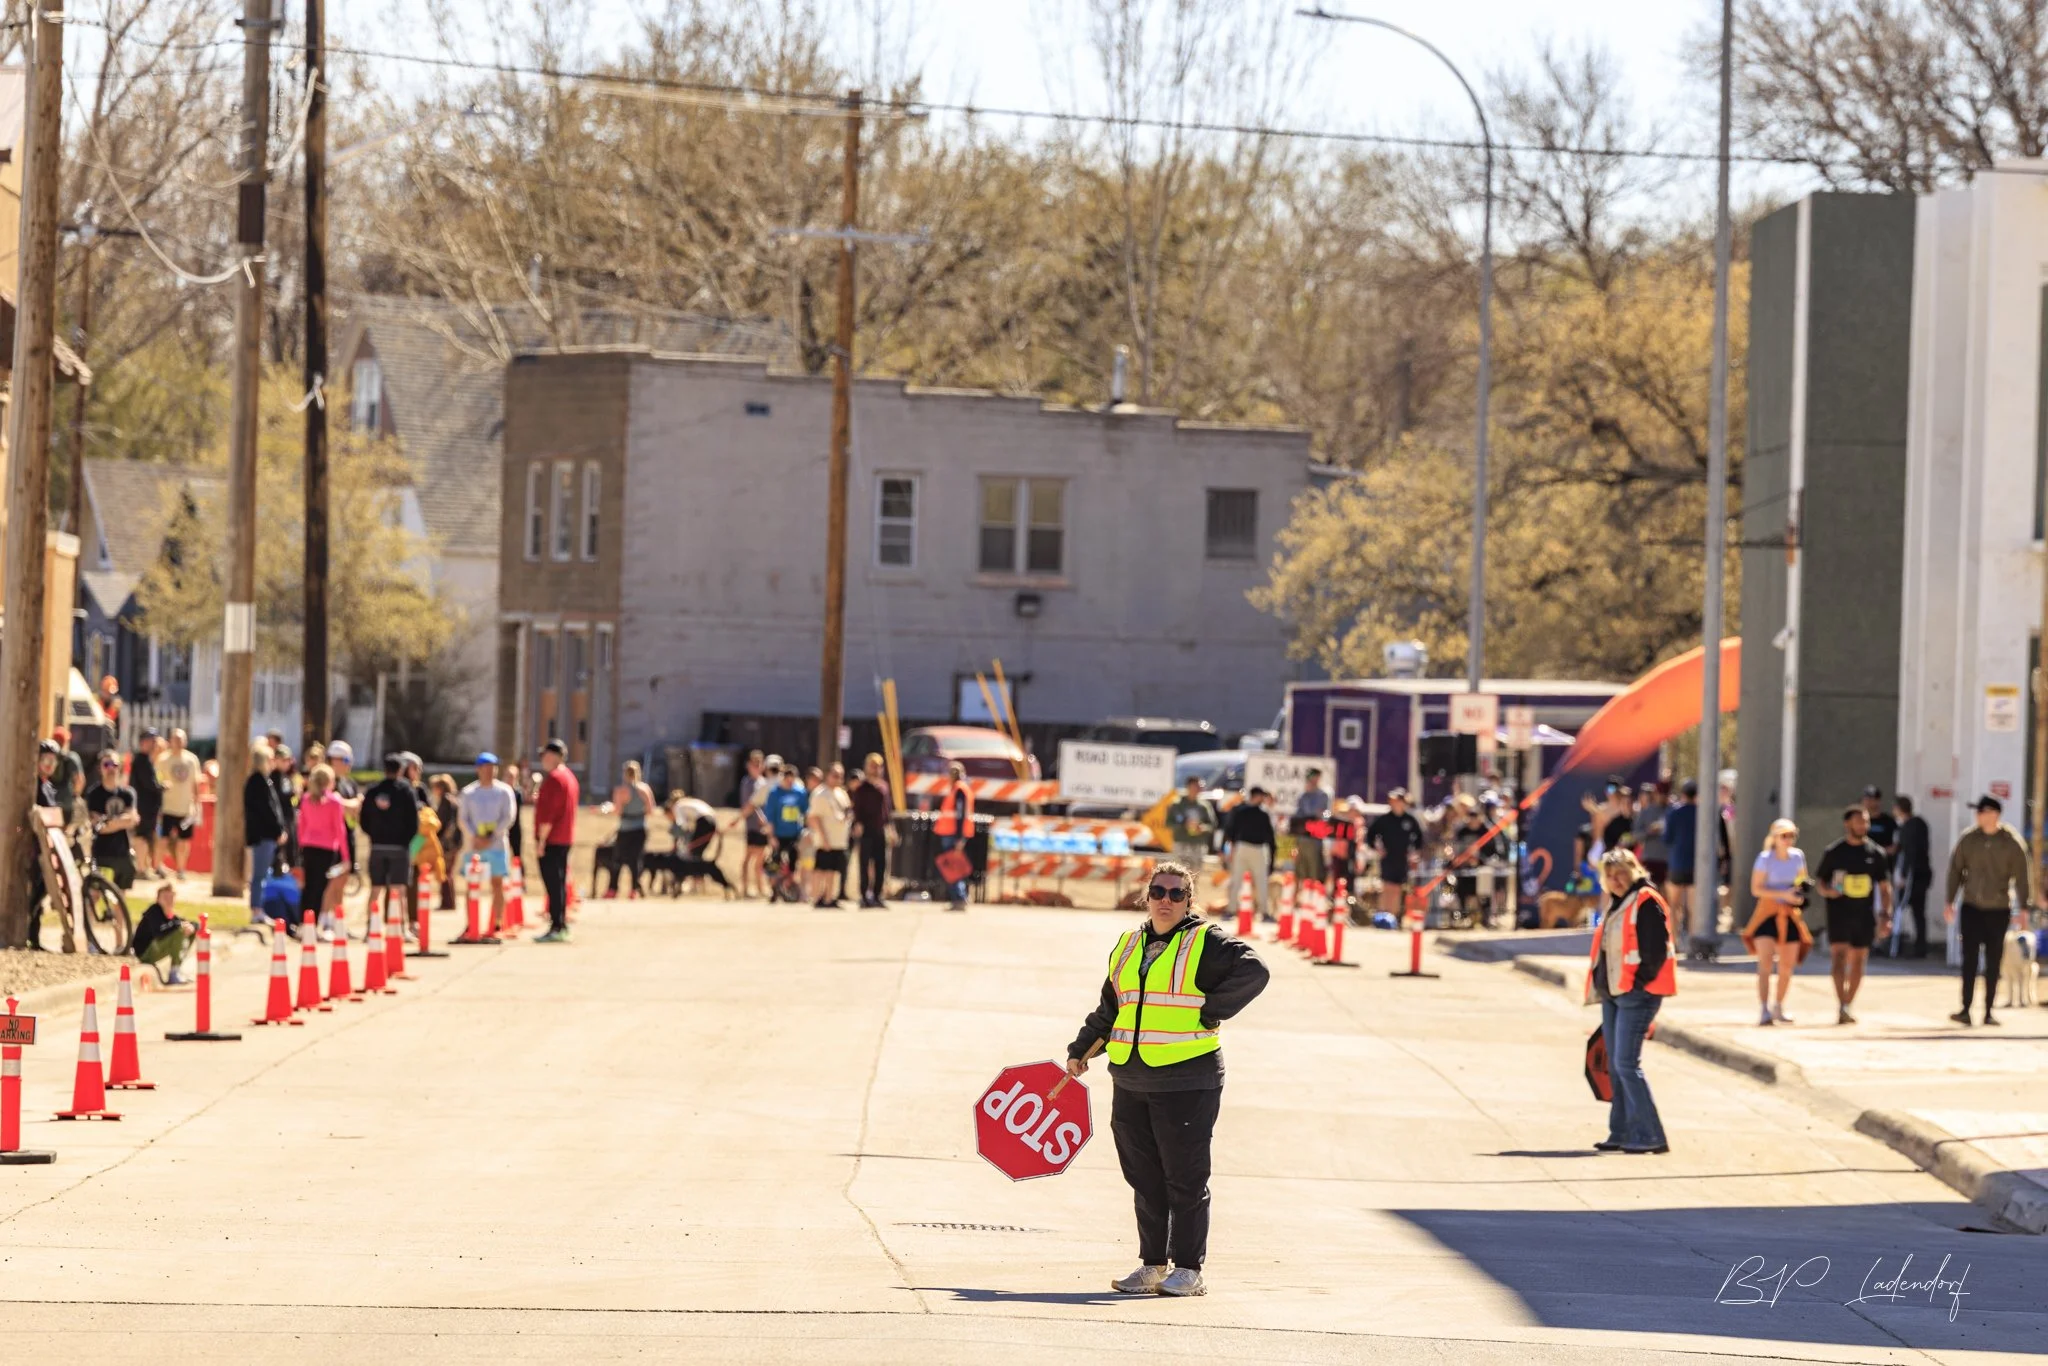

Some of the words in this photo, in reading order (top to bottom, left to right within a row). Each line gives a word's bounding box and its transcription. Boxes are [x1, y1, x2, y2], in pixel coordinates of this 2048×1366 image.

[1075, 749, 1110, 765] ROAD
[1111, 751, 1162, 768] CLOSED
[8, 1019, 20, 1030] NO
[0, 1030, 31, 1041] ARKING
[983, 1080, 1082, 1165] STOP
